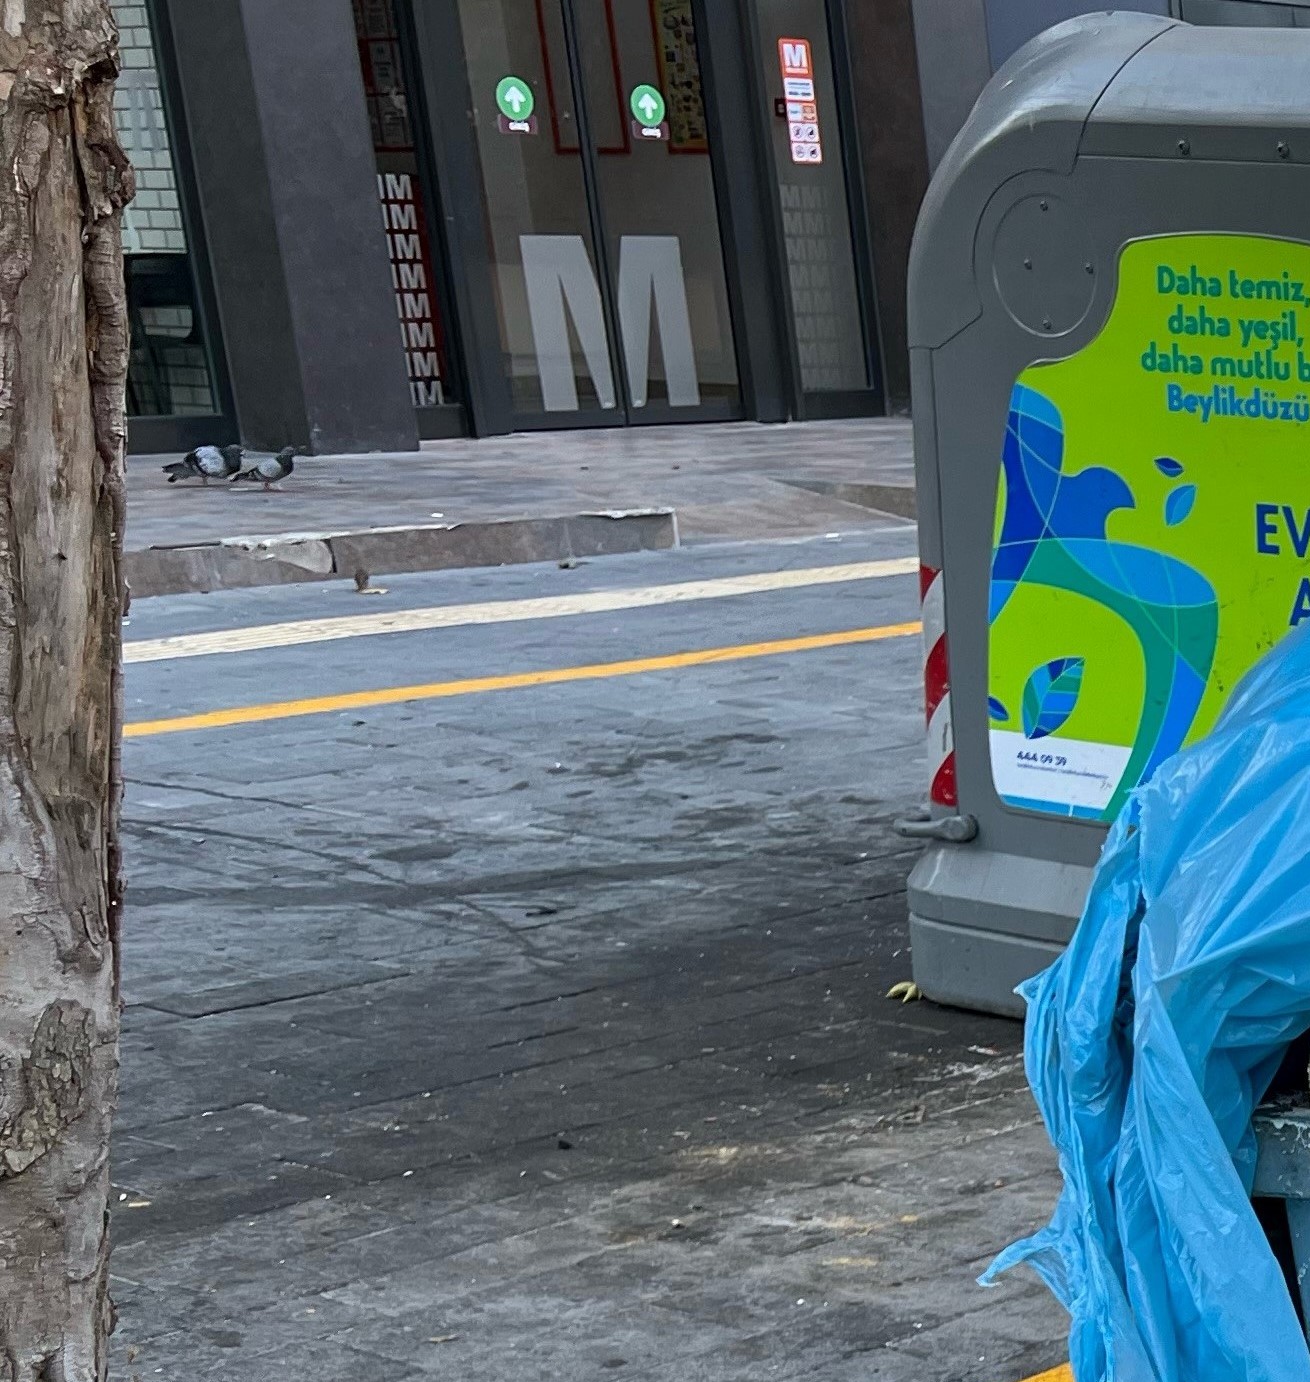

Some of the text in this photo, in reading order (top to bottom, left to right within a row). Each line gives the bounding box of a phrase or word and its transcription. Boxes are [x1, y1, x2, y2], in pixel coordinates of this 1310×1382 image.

[782, 43, 808, 69] M
[1157, 265, 1223, 297] Daha
[519, 234, 701, 412] M
[1168, 303, 1304, 350] daha yeşil,
[1141, 341, 1204, 375] daha
[1211, 350, 1291, 381] mutlu
[1167, 383, 1310, 423] Beylikdüzü
